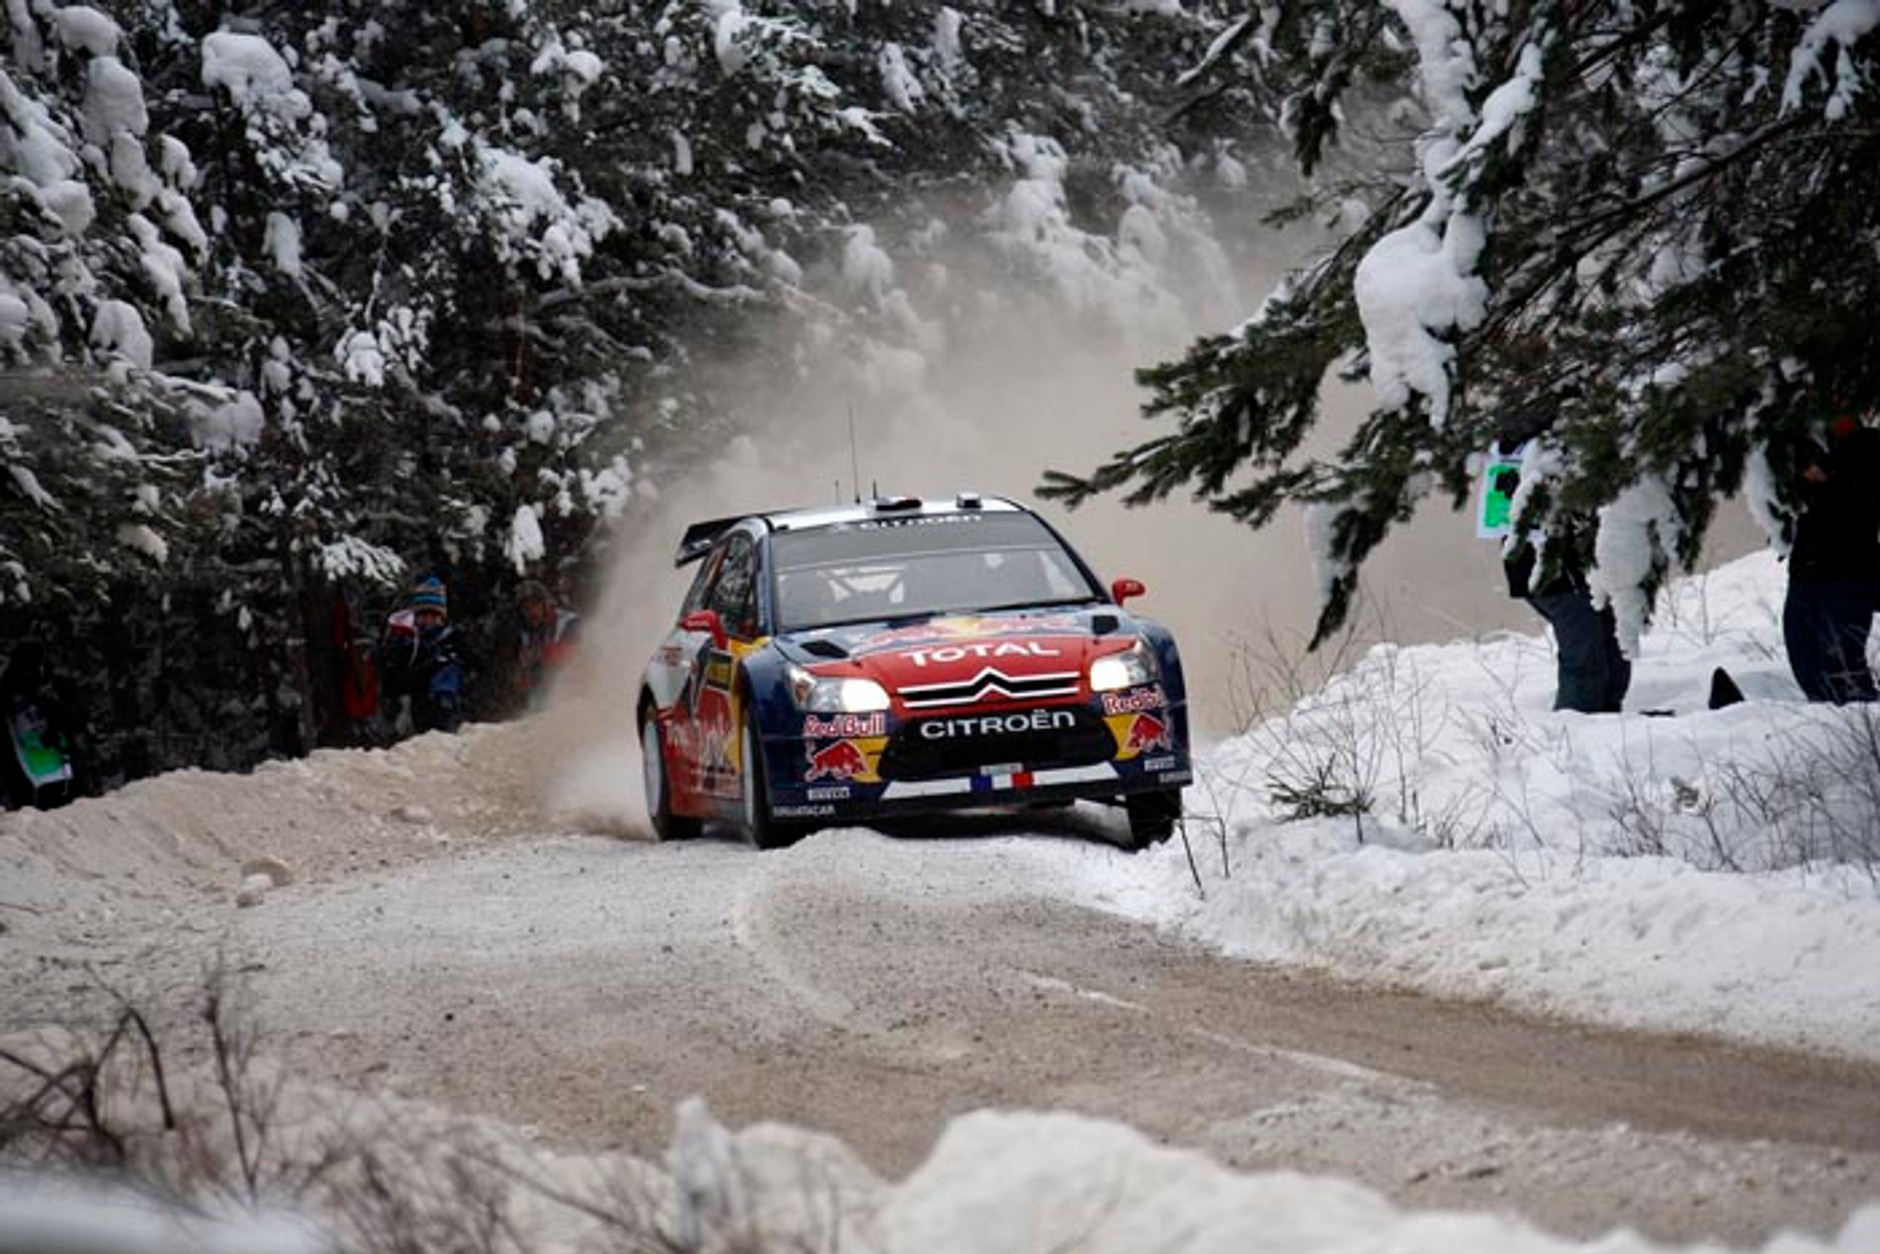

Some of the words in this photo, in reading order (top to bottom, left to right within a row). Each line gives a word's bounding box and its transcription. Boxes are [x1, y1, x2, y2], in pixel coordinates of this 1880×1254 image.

[901, 642, 1061, 666] TOTAL
[803, 714, 840, 738] Red
[840, 710, 887, 737] Bull
